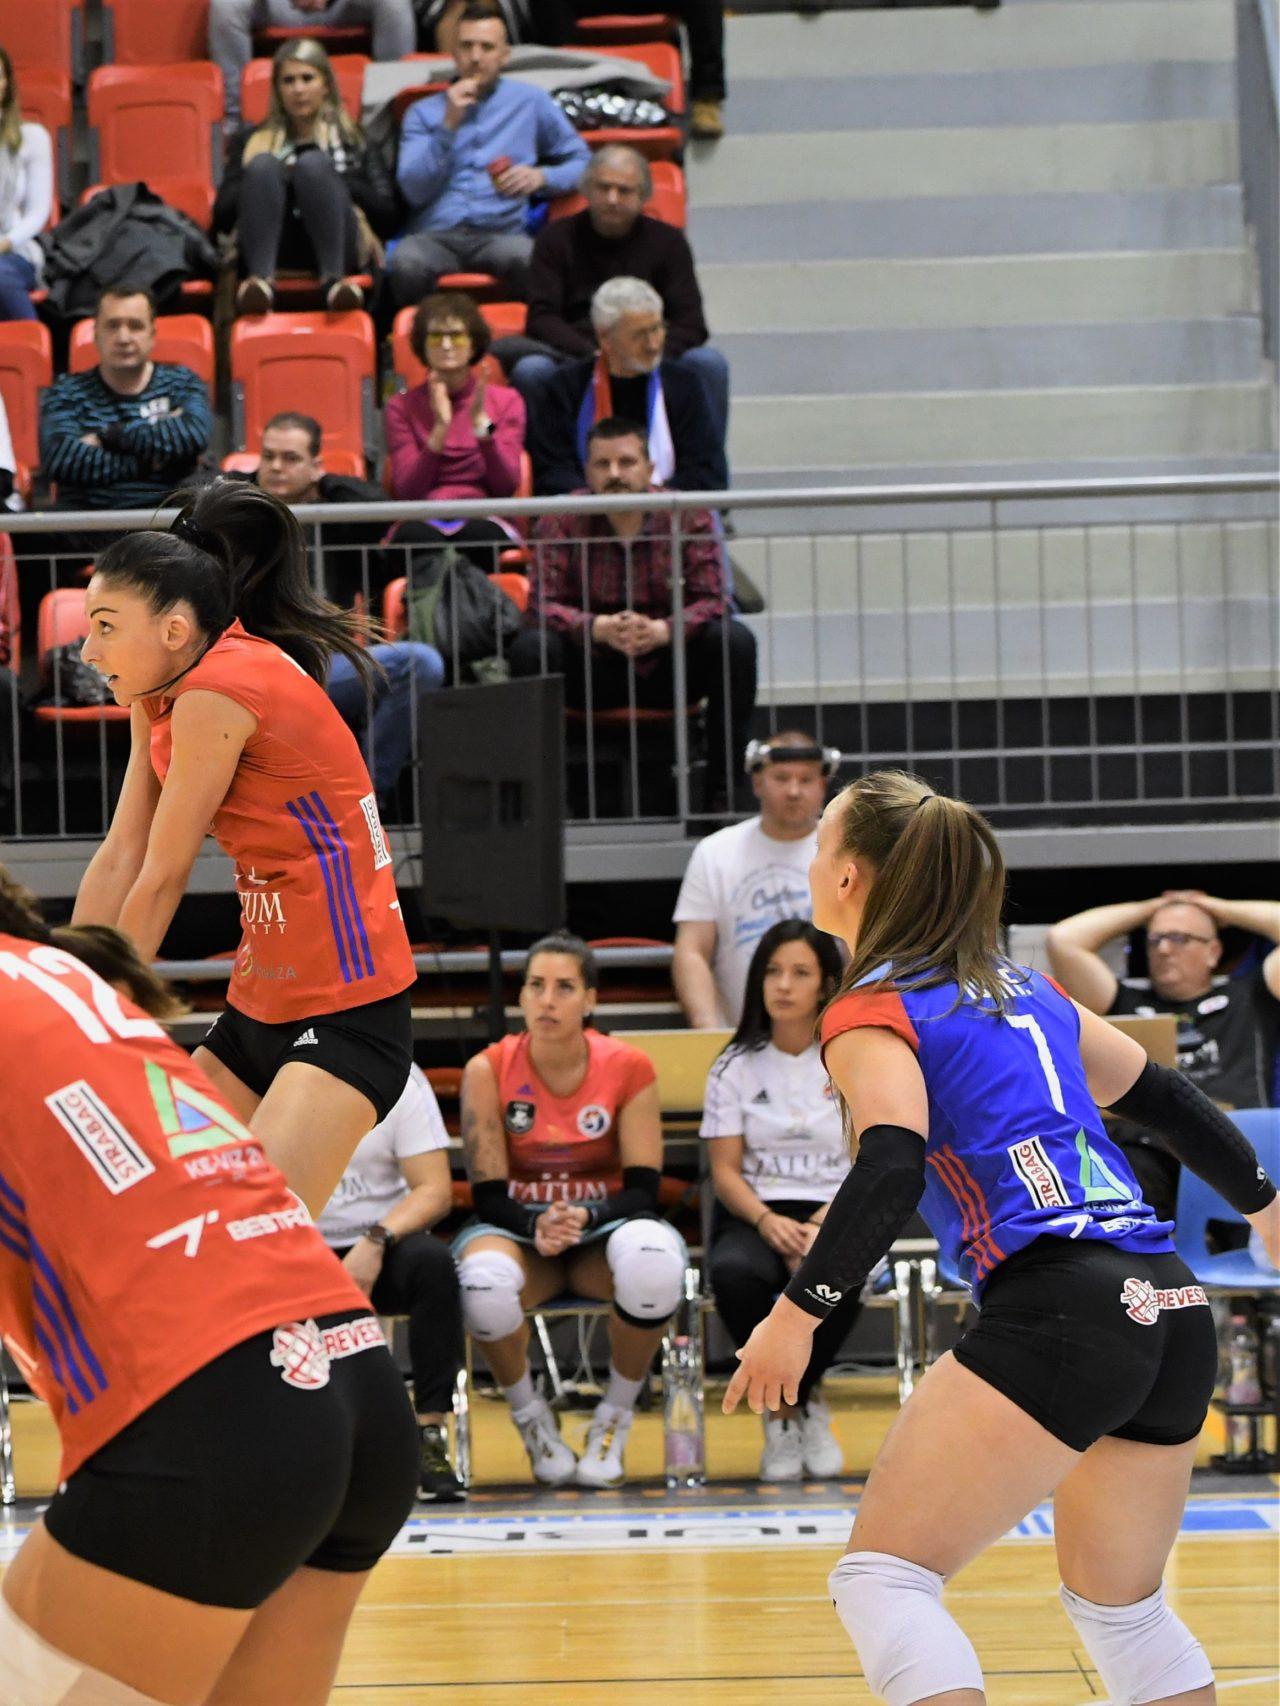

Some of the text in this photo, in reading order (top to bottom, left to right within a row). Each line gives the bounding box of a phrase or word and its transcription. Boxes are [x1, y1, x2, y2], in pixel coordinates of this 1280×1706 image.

[239, 891, 287, 923] TUM
[1005, 1014, 1067, 1115] 7
[64, 1092, 138, 1180] STRABAG
[1020, 1143, 1061, 1207] STRABAG
